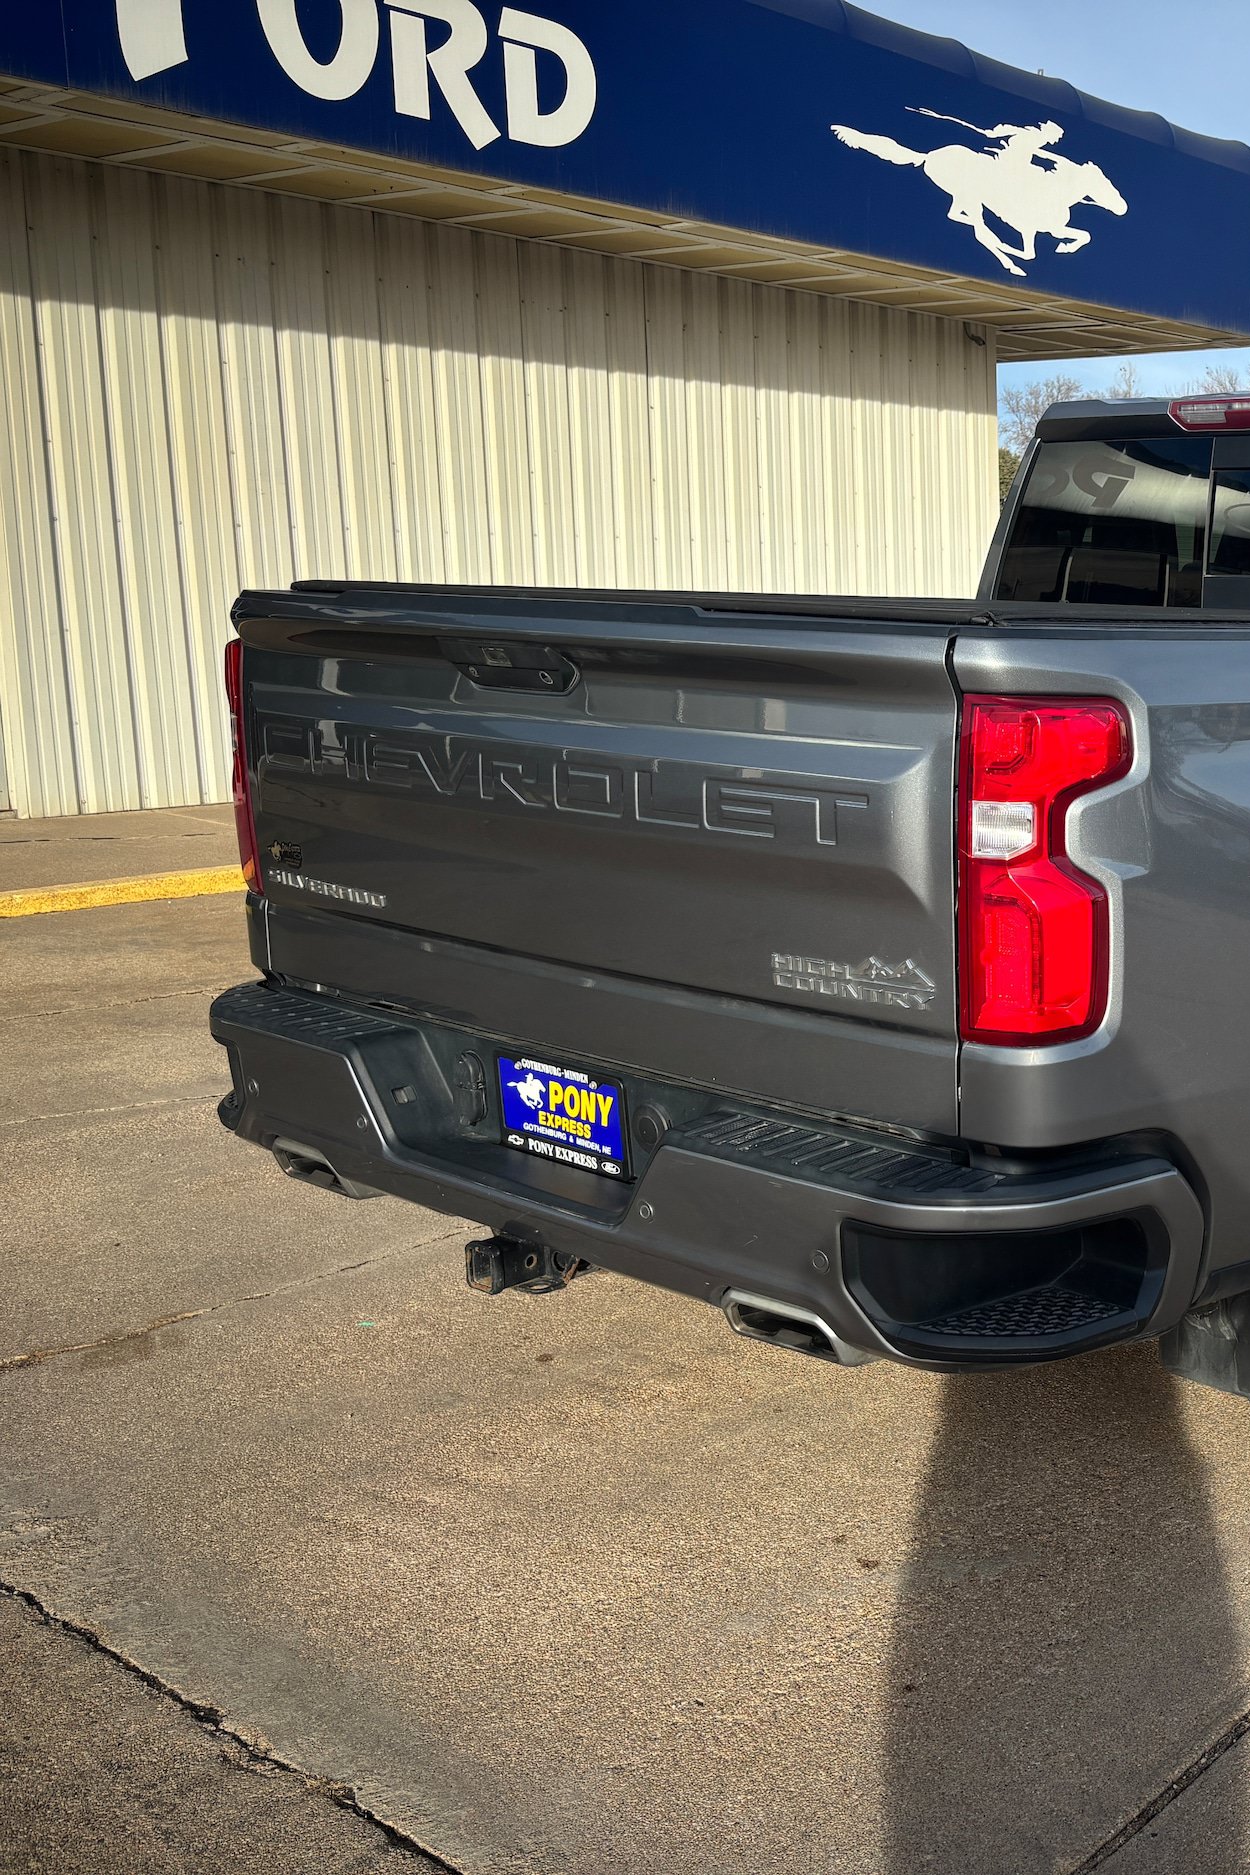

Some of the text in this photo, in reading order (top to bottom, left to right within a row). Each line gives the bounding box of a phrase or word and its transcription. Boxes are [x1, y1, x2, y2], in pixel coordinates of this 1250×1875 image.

[263, 723, 869, 846] CHEVROLET
[267, 868, 387, 908] SILVERADO
[771, 952, 850, 979] HIGH
[772, 973, 936, 1010] COUNTRY
[548, 1080, 614, 1127] PONY
[522, 1122, 567, 1141] GOTHENBURG
[538, 1110, 592, 1139] EXPRESS
[527, 1137, 554, 1157] PONY
[554, 1145, 598, 1170] EXPRESS
